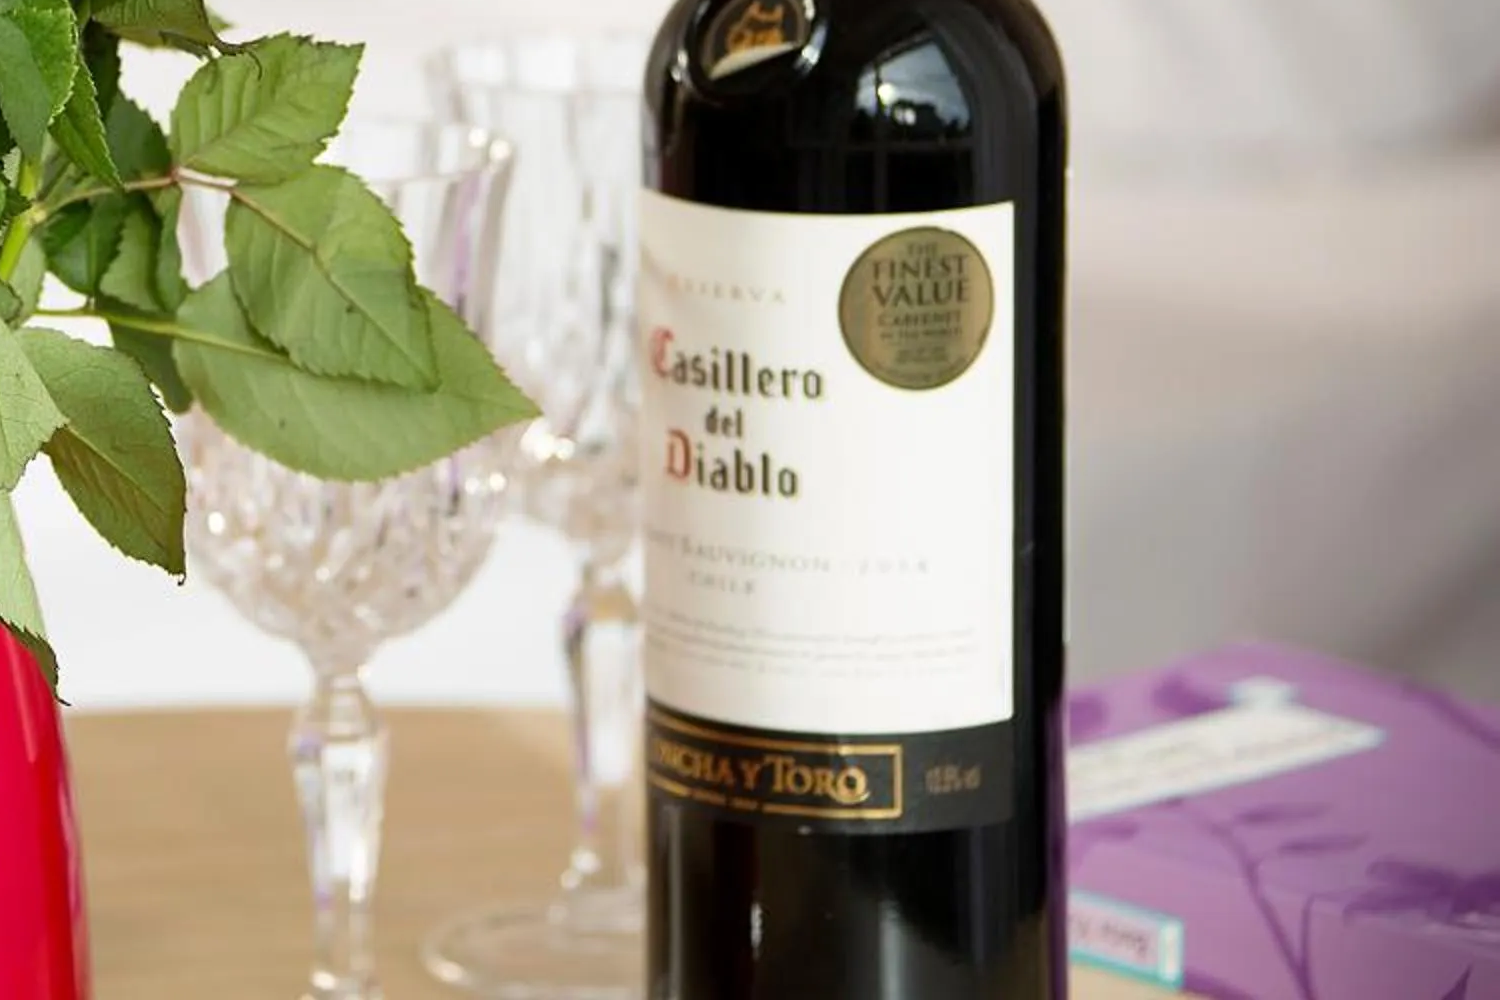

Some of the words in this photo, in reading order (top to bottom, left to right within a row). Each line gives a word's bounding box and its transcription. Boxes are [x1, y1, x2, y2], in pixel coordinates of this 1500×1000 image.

[872, 255, 969, 281] FINEST
[872, 278, 970, 308] VALUE
[651, 327, 822, 399] Casillero
[705, 405, 743, 438] del
[667, 428, 798, 498] Diablo
[740, 756, 763, 790] Y
[764, 752, 871, 805] TORO
